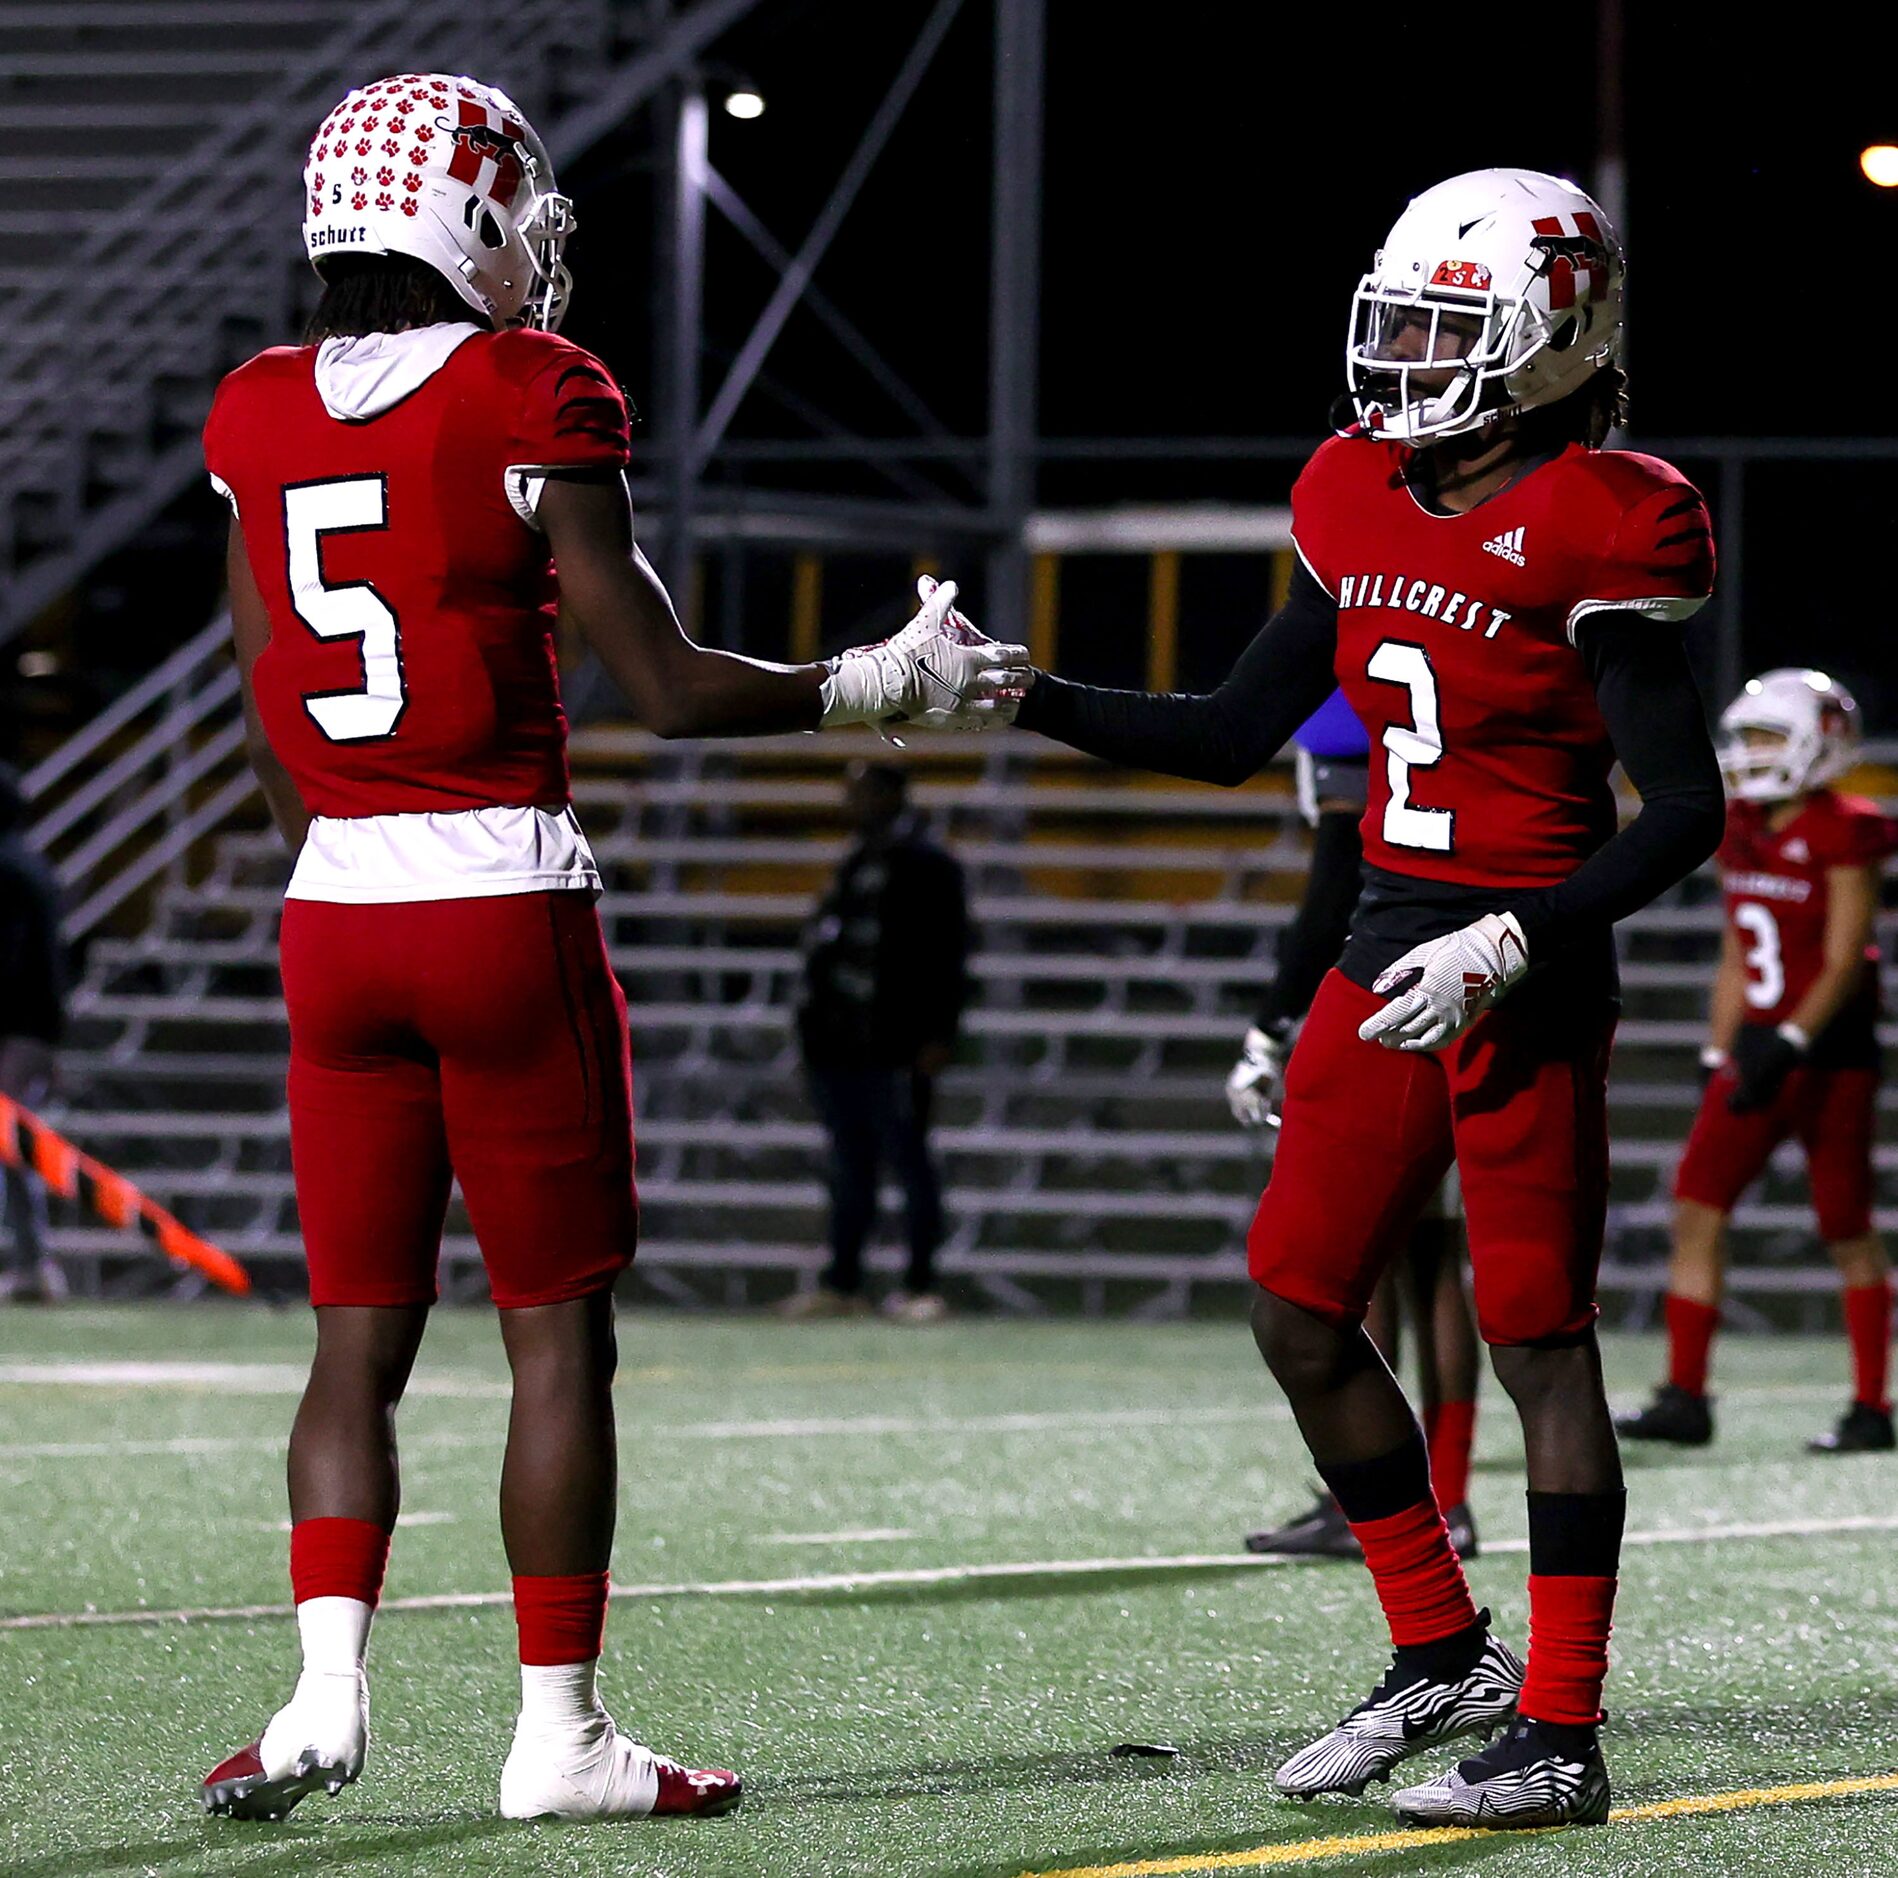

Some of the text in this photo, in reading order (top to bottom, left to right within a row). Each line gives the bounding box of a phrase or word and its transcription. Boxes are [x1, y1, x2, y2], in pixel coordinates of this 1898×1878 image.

[1337, 573, 1513, 640] HILLCREST
[1482, 541, 1526, 567] adidas
[282, 472, 408, 745] 5
[1366, 638, 1456, 856] 2
[1735, 902, 1785, 1009] 3
